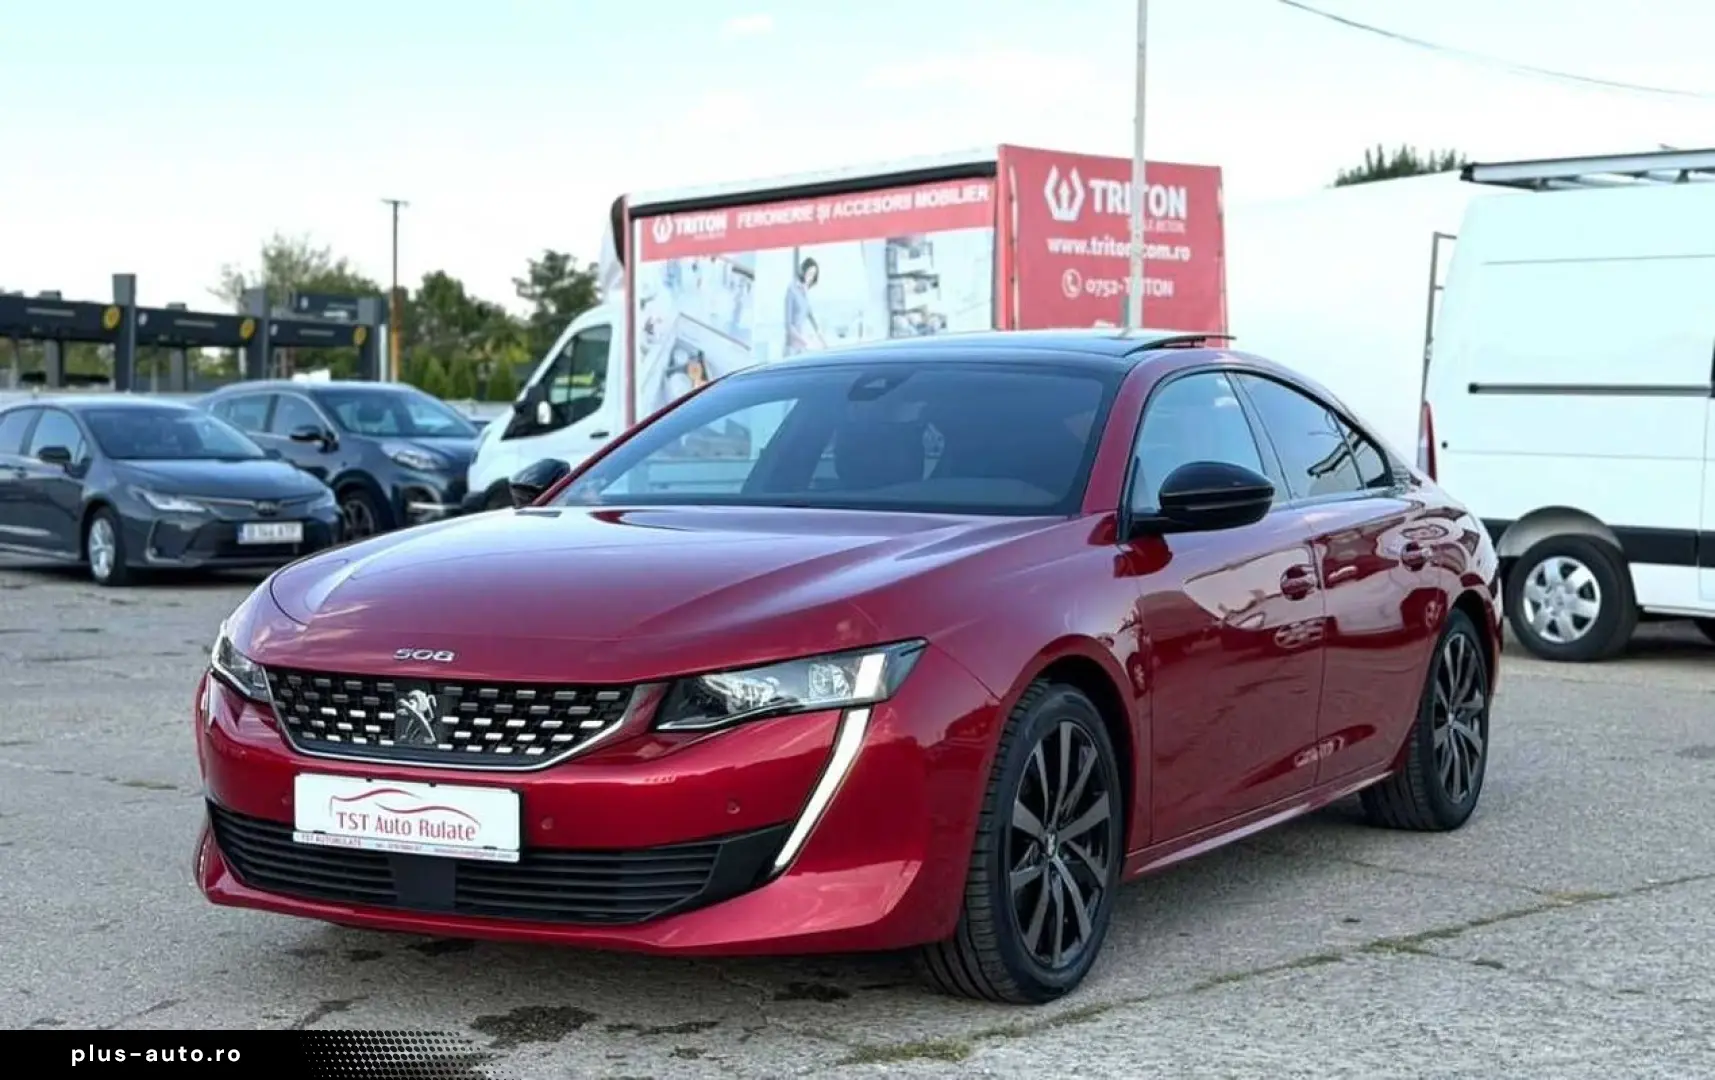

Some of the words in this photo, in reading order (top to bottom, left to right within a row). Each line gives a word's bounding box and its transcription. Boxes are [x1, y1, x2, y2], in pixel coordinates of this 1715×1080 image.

[675, 212, 727, 235] TRITON
[915, 183, 988, 209] MOBILIER
[1088, 177, 1187, 218] TRION
[393, 648, 455, 661] 508
[336, 811, 370, 831] TST
[375, 816, 412, 837] Auto
[419, 819, 476, 841] Rulate
